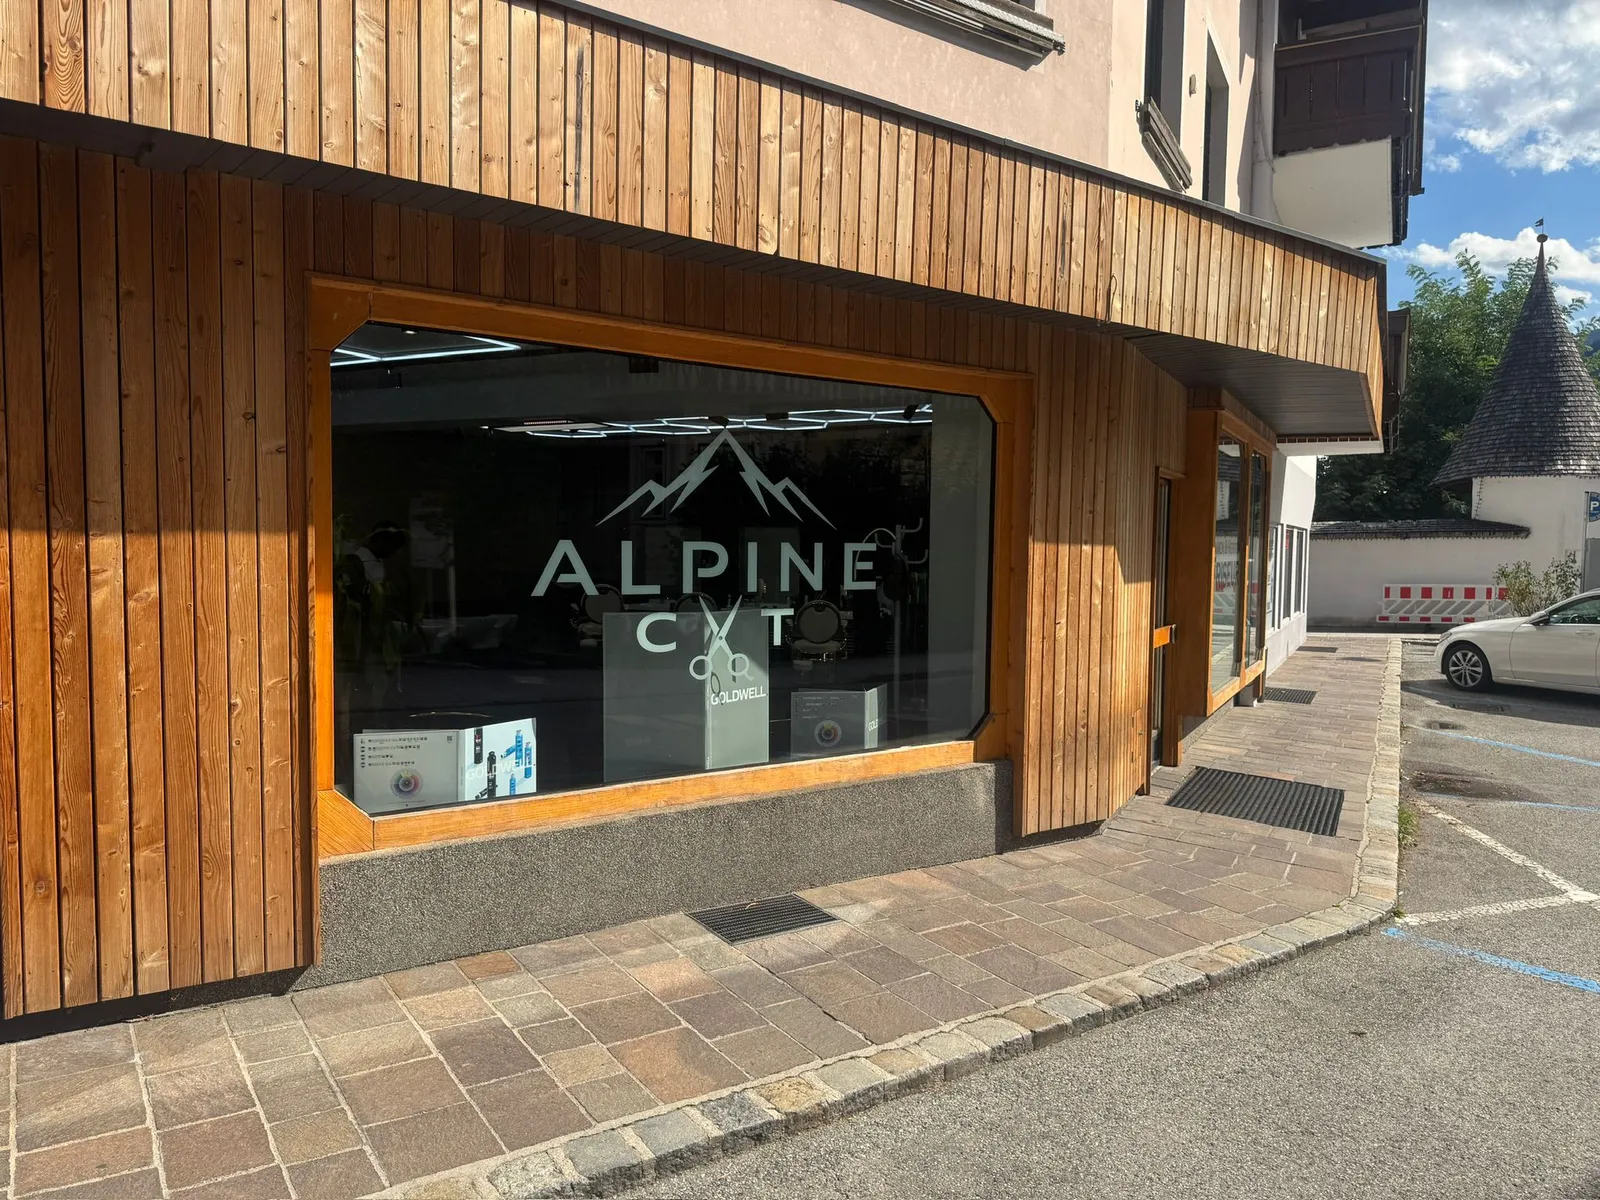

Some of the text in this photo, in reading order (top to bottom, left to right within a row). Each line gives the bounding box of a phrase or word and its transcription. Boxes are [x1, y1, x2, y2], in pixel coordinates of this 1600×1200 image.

[1590, 501, 1600, 511] P
[530, 539, 877, 597] ALPINE
[710, 685, 767, 706] GOLDWELL
